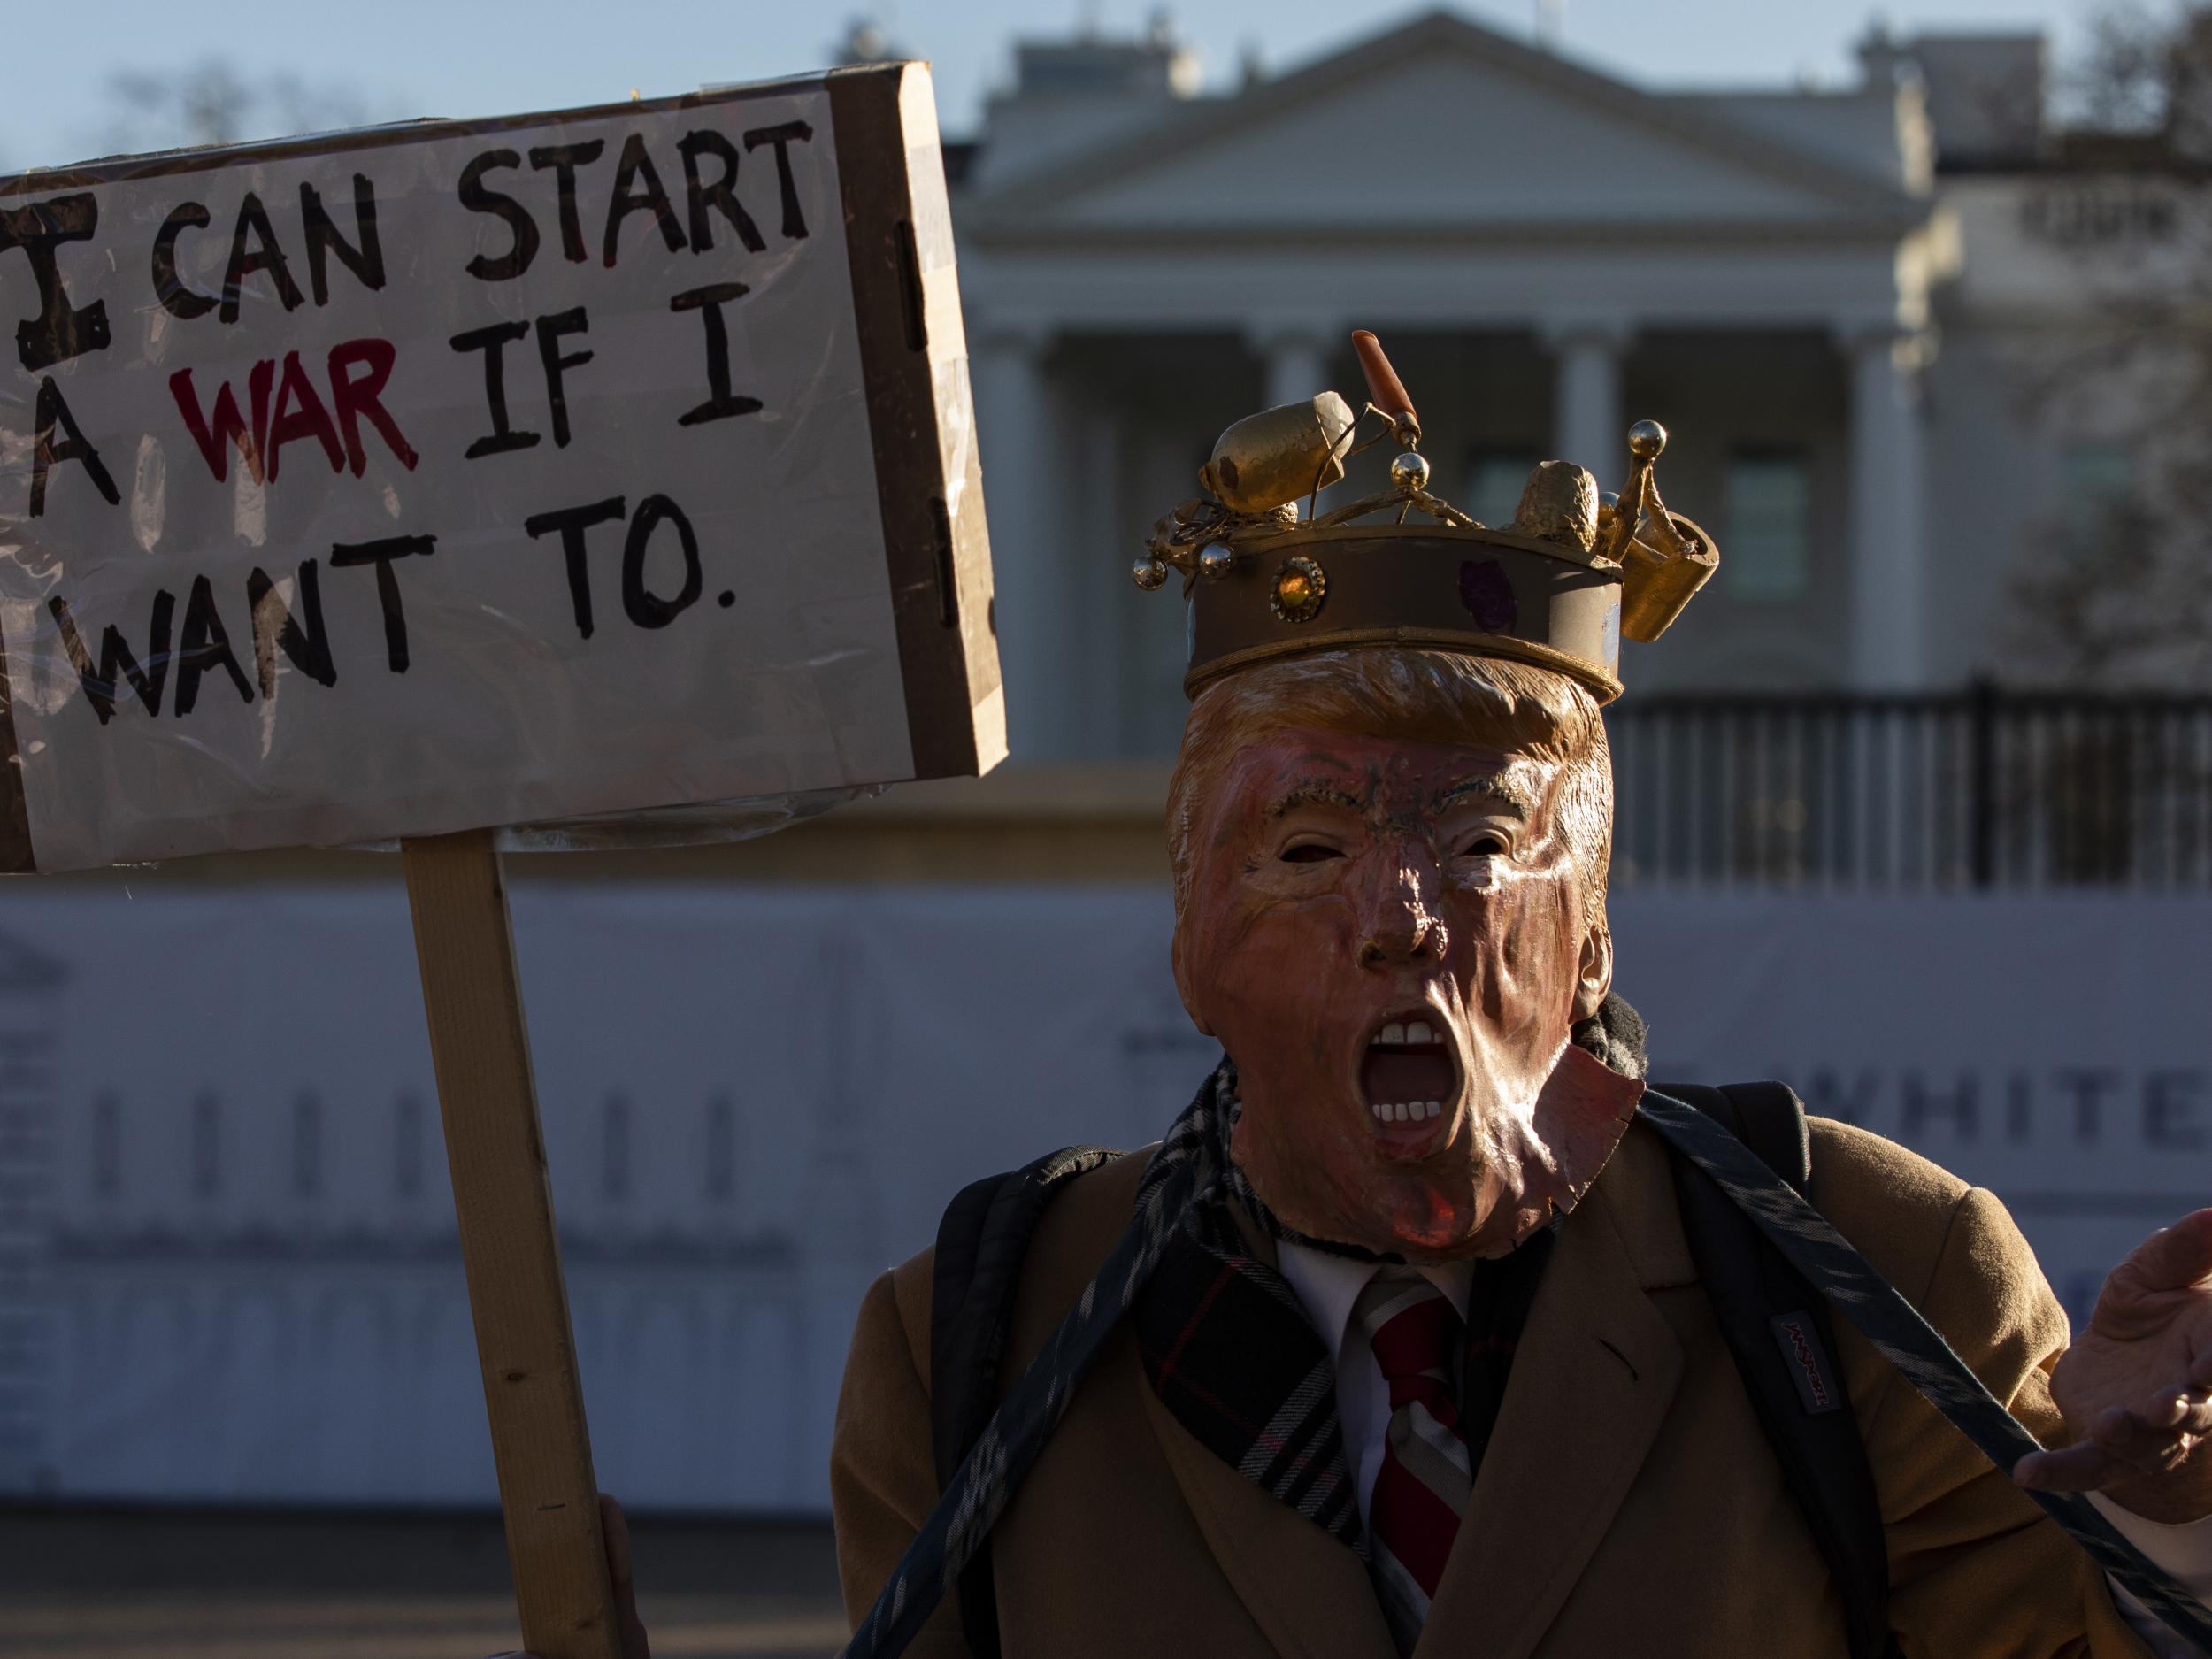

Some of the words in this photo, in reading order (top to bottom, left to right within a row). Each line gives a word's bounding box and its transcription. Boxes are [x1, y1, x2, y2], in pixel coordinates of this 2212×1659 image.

[0, 192, 111, 372] I
[151, 173, 387, 324] CAN
[457, 120, 813, 281] START
[29, 375, 122, 517] A
[169, 338, 419, 485] WAR
[449, 306, 595, 459] IF
[670, 282, 764, 426] I
[48, 534, 437, 725] WANT
[524, 494, 736, 640] TO.
